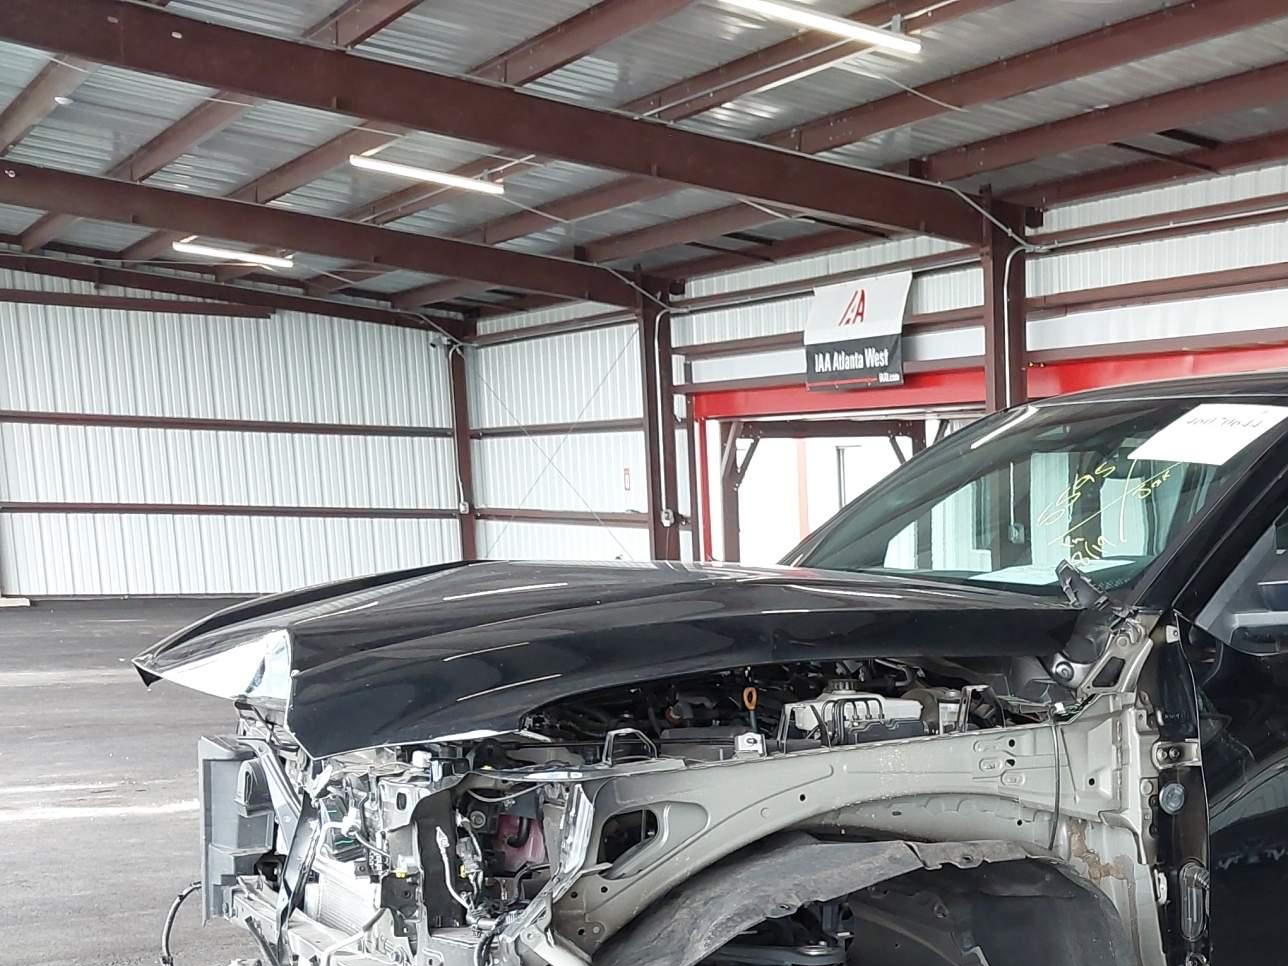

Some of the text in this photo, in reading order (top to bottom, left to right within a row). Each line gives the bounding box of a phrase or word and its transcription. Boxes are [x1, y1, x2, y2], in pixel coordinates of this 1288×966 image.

[815, 346, 889, 373] IAA Atlanta West
